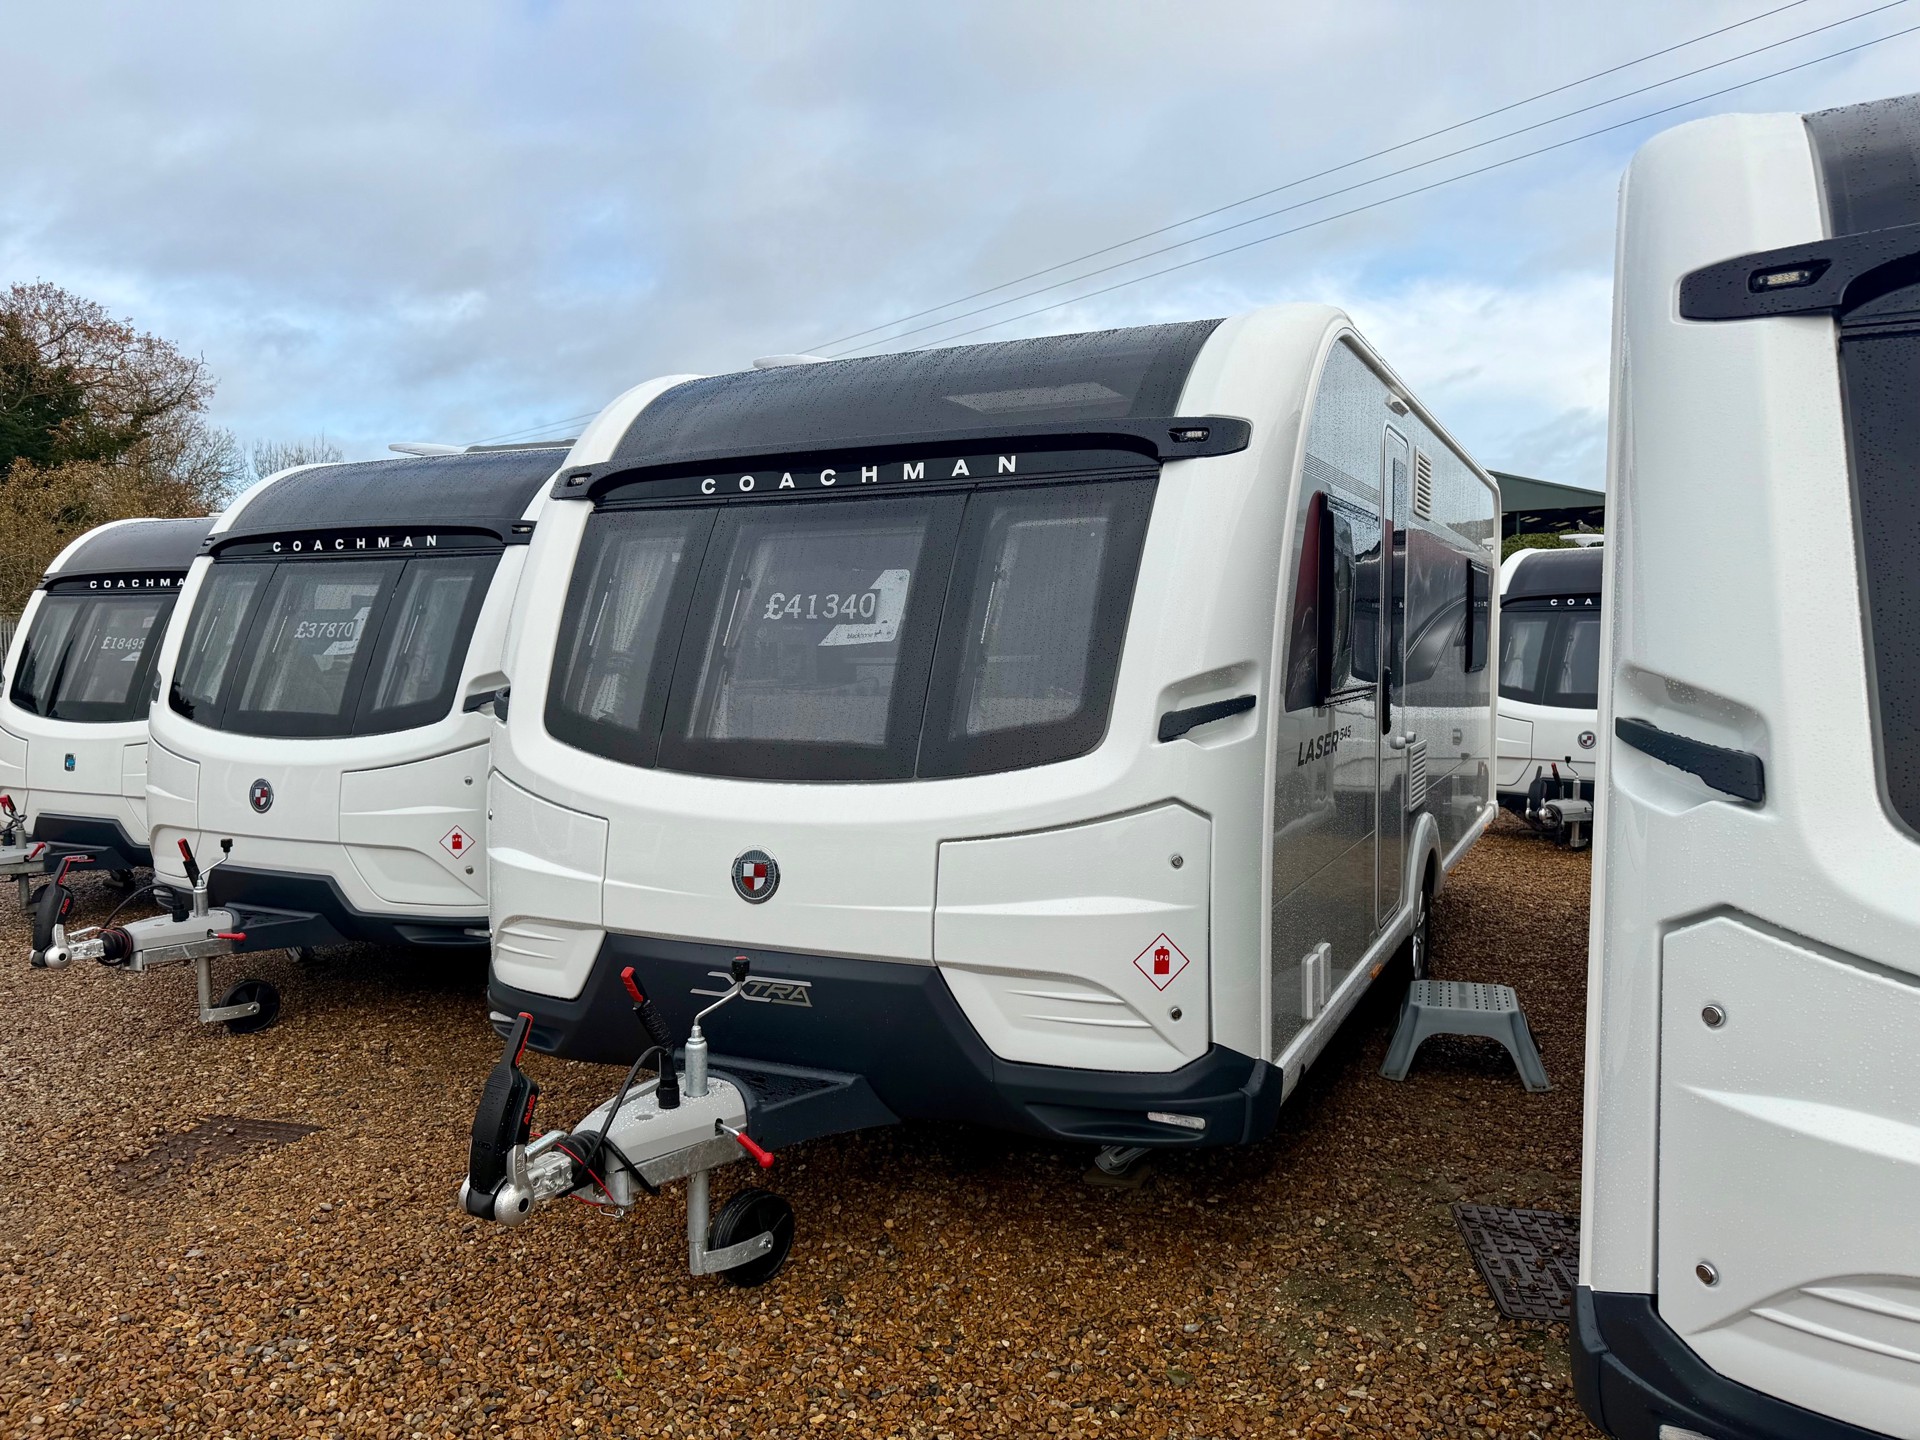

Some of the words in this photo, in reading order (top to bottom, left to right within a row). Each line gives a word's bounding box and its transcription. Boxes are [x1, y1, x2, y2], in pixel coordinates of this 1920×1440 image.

[701, 455, 1017, 494] COACHMAN
[272, 535, 437, 552] COACHMAN
[763, 592, 876, 620] £41340
[294, 621, 354, 638] £37870
[101, 636, 146, 650] £18495
[1297, 730, 1339, 767] LASER
[1339, 725, 1352, 740] 545
